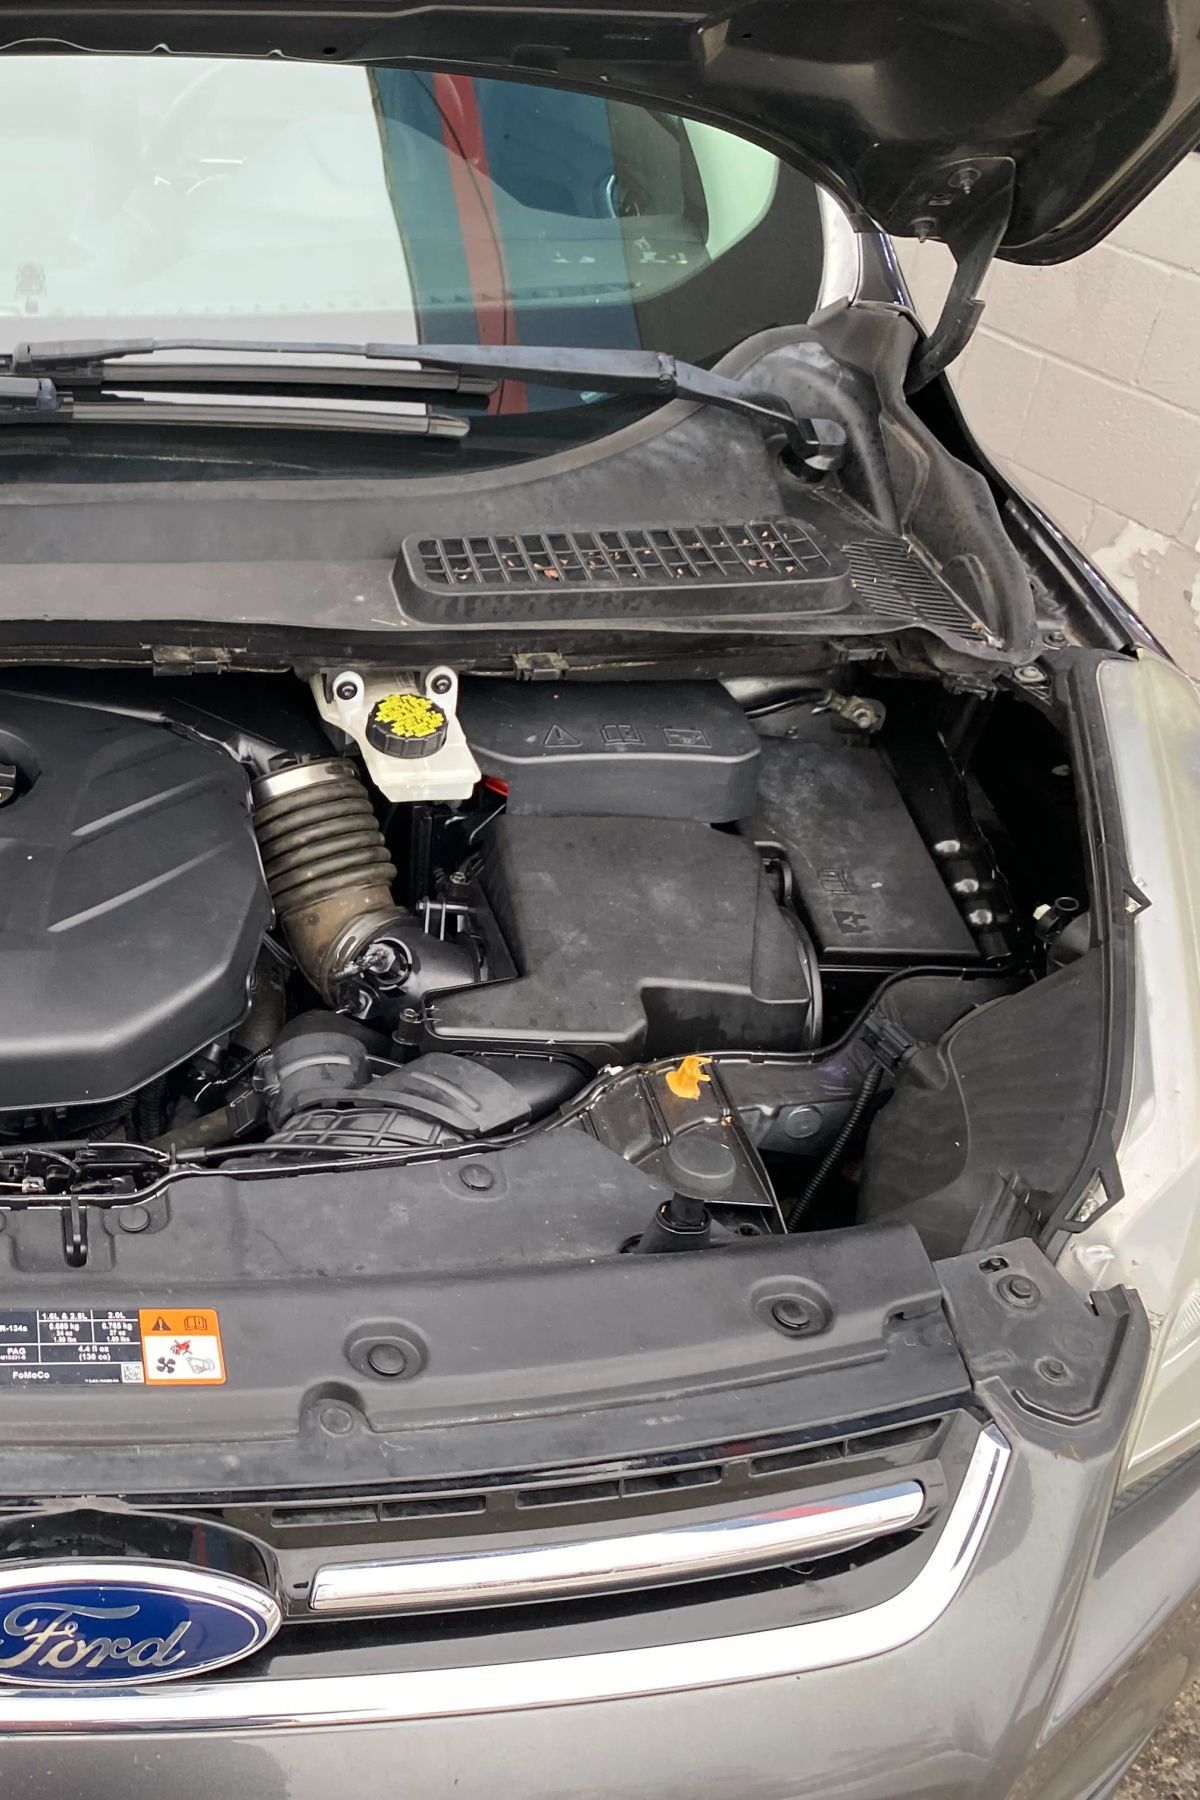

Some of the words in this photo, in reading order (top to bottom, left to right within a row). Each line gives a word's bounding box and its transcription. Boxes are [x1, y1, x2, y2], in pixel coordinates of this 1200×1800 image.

[107, 1311, 126, 1319] 2.0L
[0, 1324, 28, 1333] R-134a
[69, 1322, 80, 1332] kg
[123, 1322, 133, 1331] kg
[6, 1347, 27, 1355] PAG
[77, 1345, 90, 1353] 4.4
[79, 1353, 96, 1361] (130
[12, 1370, 50, 1379] FoMoCo
